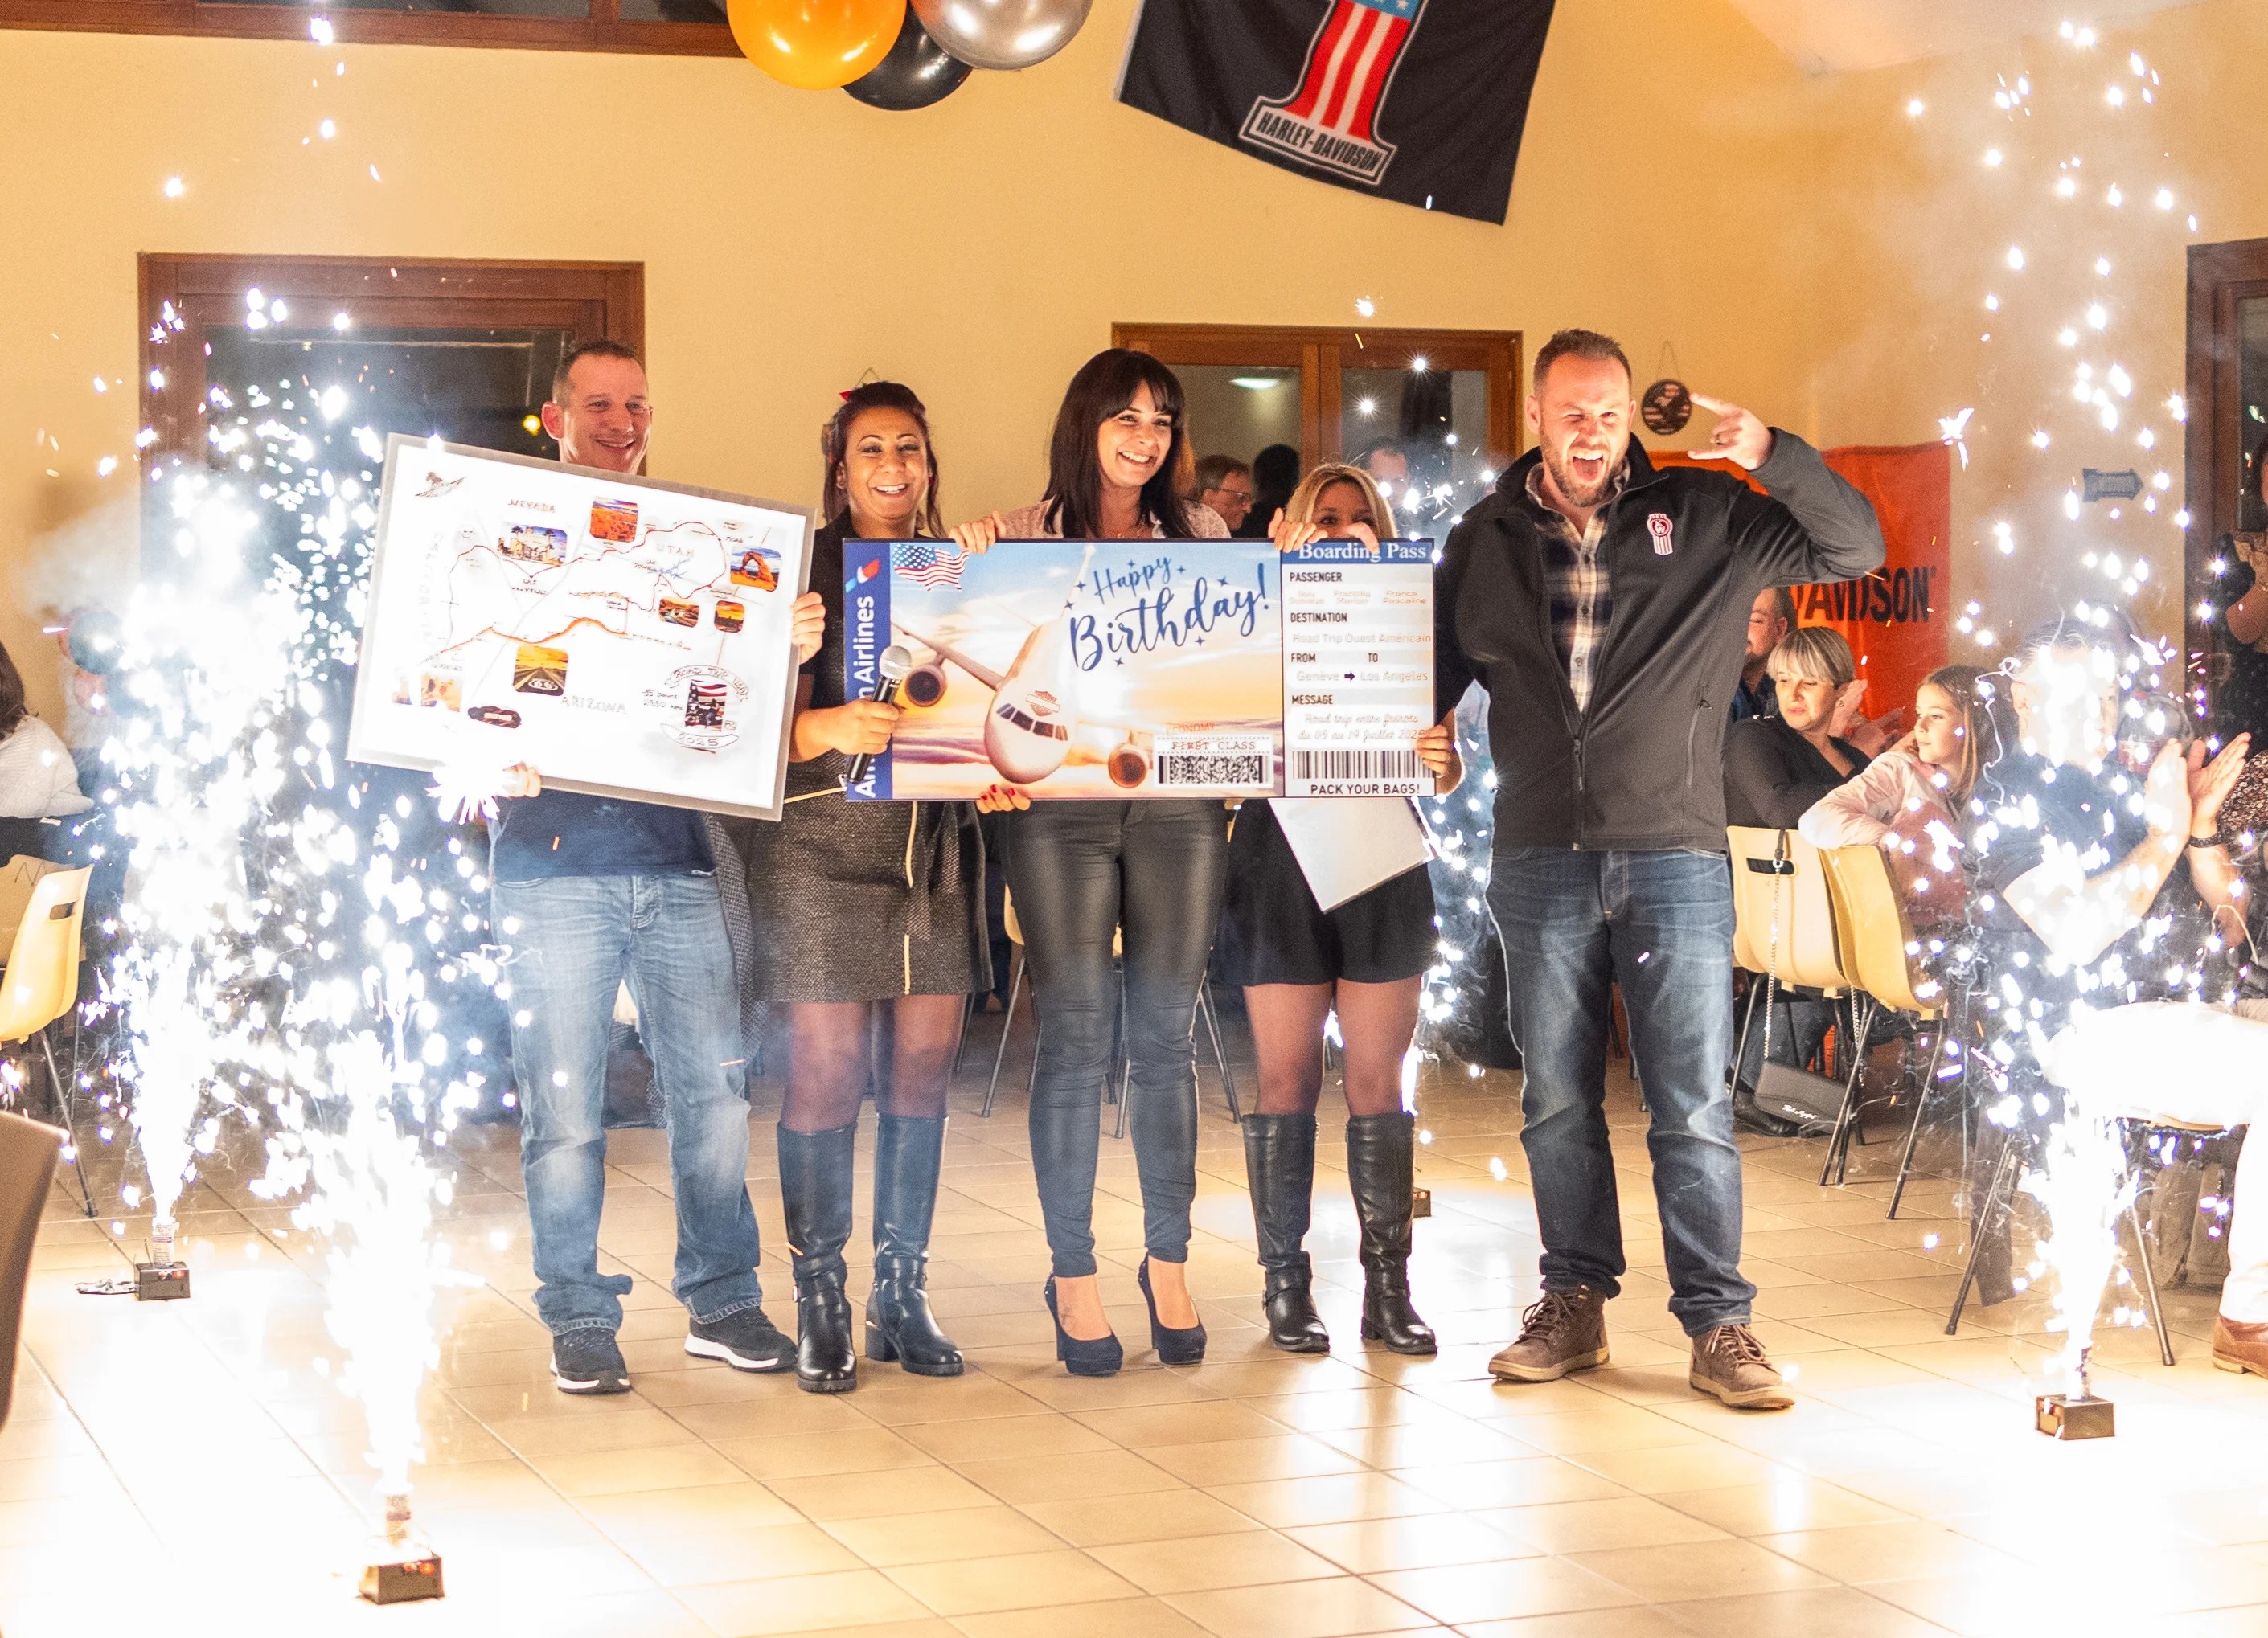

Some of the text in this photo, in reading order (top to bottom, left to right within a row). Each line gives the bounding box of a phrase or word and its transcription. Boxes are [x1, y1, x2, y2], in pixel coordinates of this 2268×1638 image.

[1256, 111, 1383, 171] HARLEY-DAVIDSON
[1387, 543, 1426, 559] Pass
[1093, 557, 1171, 604] Happy
[1290, 571, 1343, 582] PASSENGER
[1794, 566, 1929, 623] AVIDSON
[1070, 563, 1269, 672] Birthday!
[1290, 612, 1347, 623] DESTINATION
[852, 596, 875, 684] Airlines
[1294, 633, 1319, 643] Road
[1323, 633, 1343, 645] Trip
[1290, 653, 1378, 662] FROM TO
[1360, 670, 1380, 681] Los
[1383, 670, 1429, 682] Angeles
[560, 695, 626, 715] ARIZONA
[1291, 694, 1333, 705] MESSAGE
[676, 733, 718, 747] 2025
[1171, 740, 1256, 750] FIRST CLASS
[1310, 784, 1421, 794] PACK YOUR BAGS!
